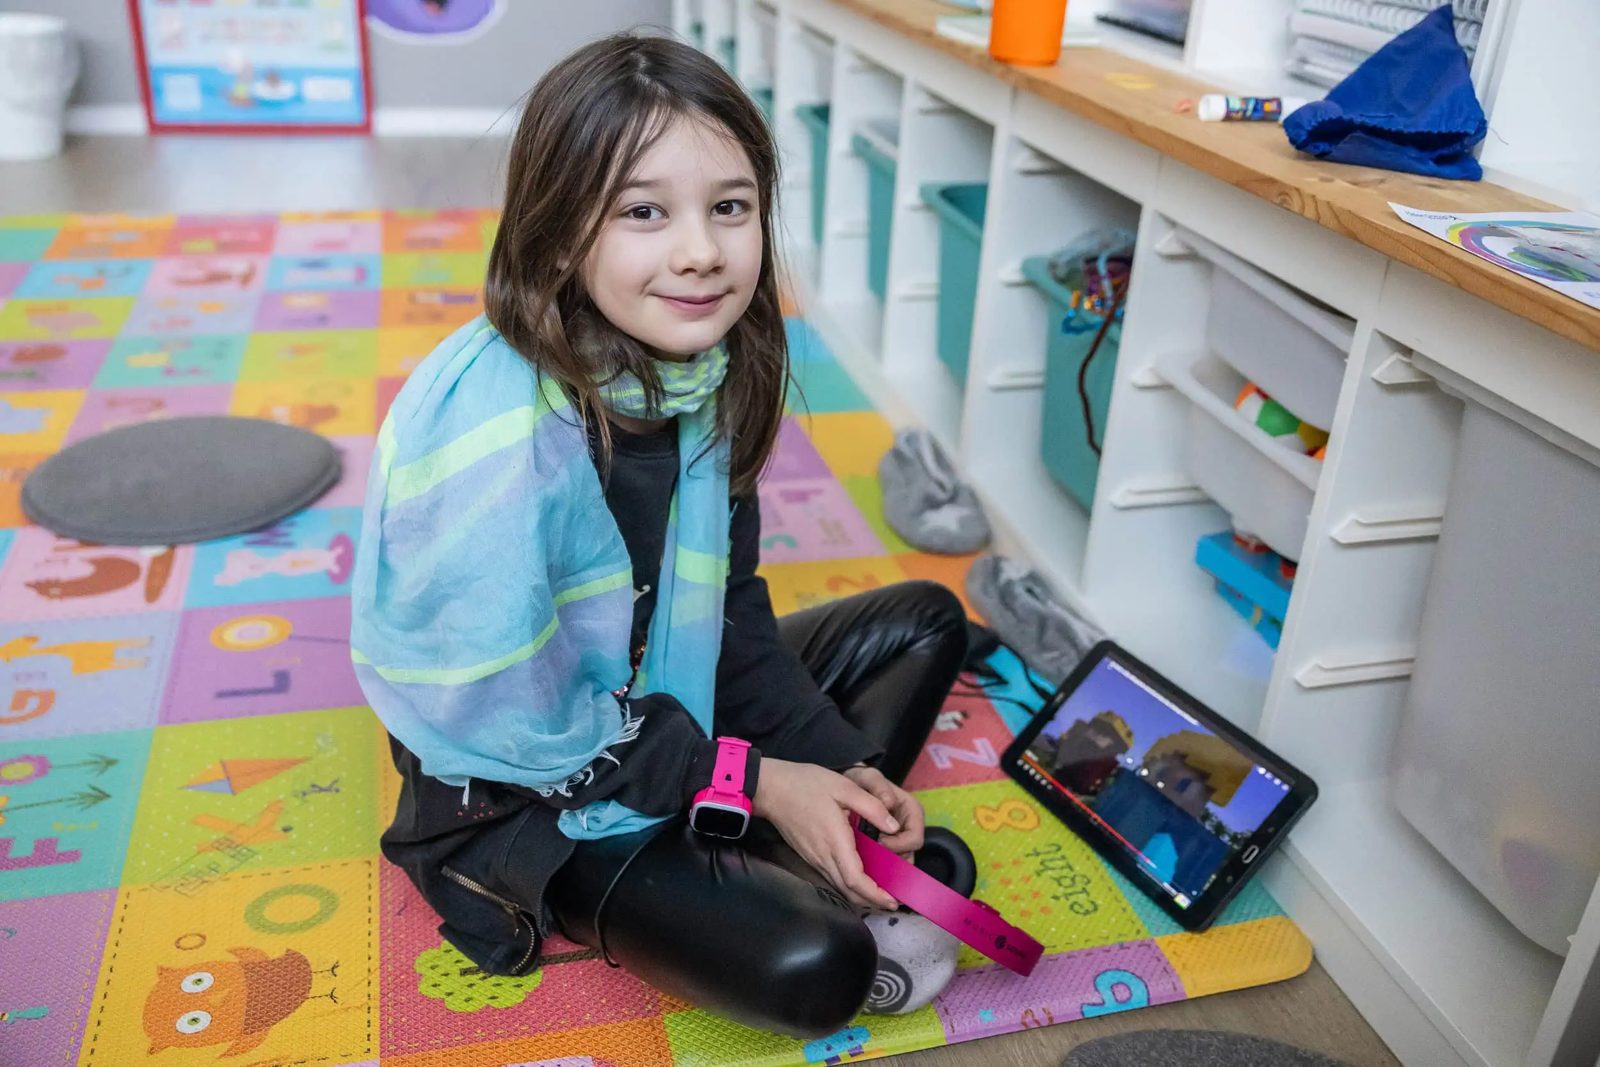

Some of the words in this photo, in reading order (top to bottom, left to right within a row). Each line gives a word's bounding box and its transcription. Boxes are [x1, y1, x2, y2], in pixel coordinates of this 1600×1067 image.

[214, 669, 292, 699] L
[927, 737, 999, 769] Z
[191, 799, 290, 855] K
[973, 796, 1041, 833] 8
[1025, 843, 1099, 917] eight
